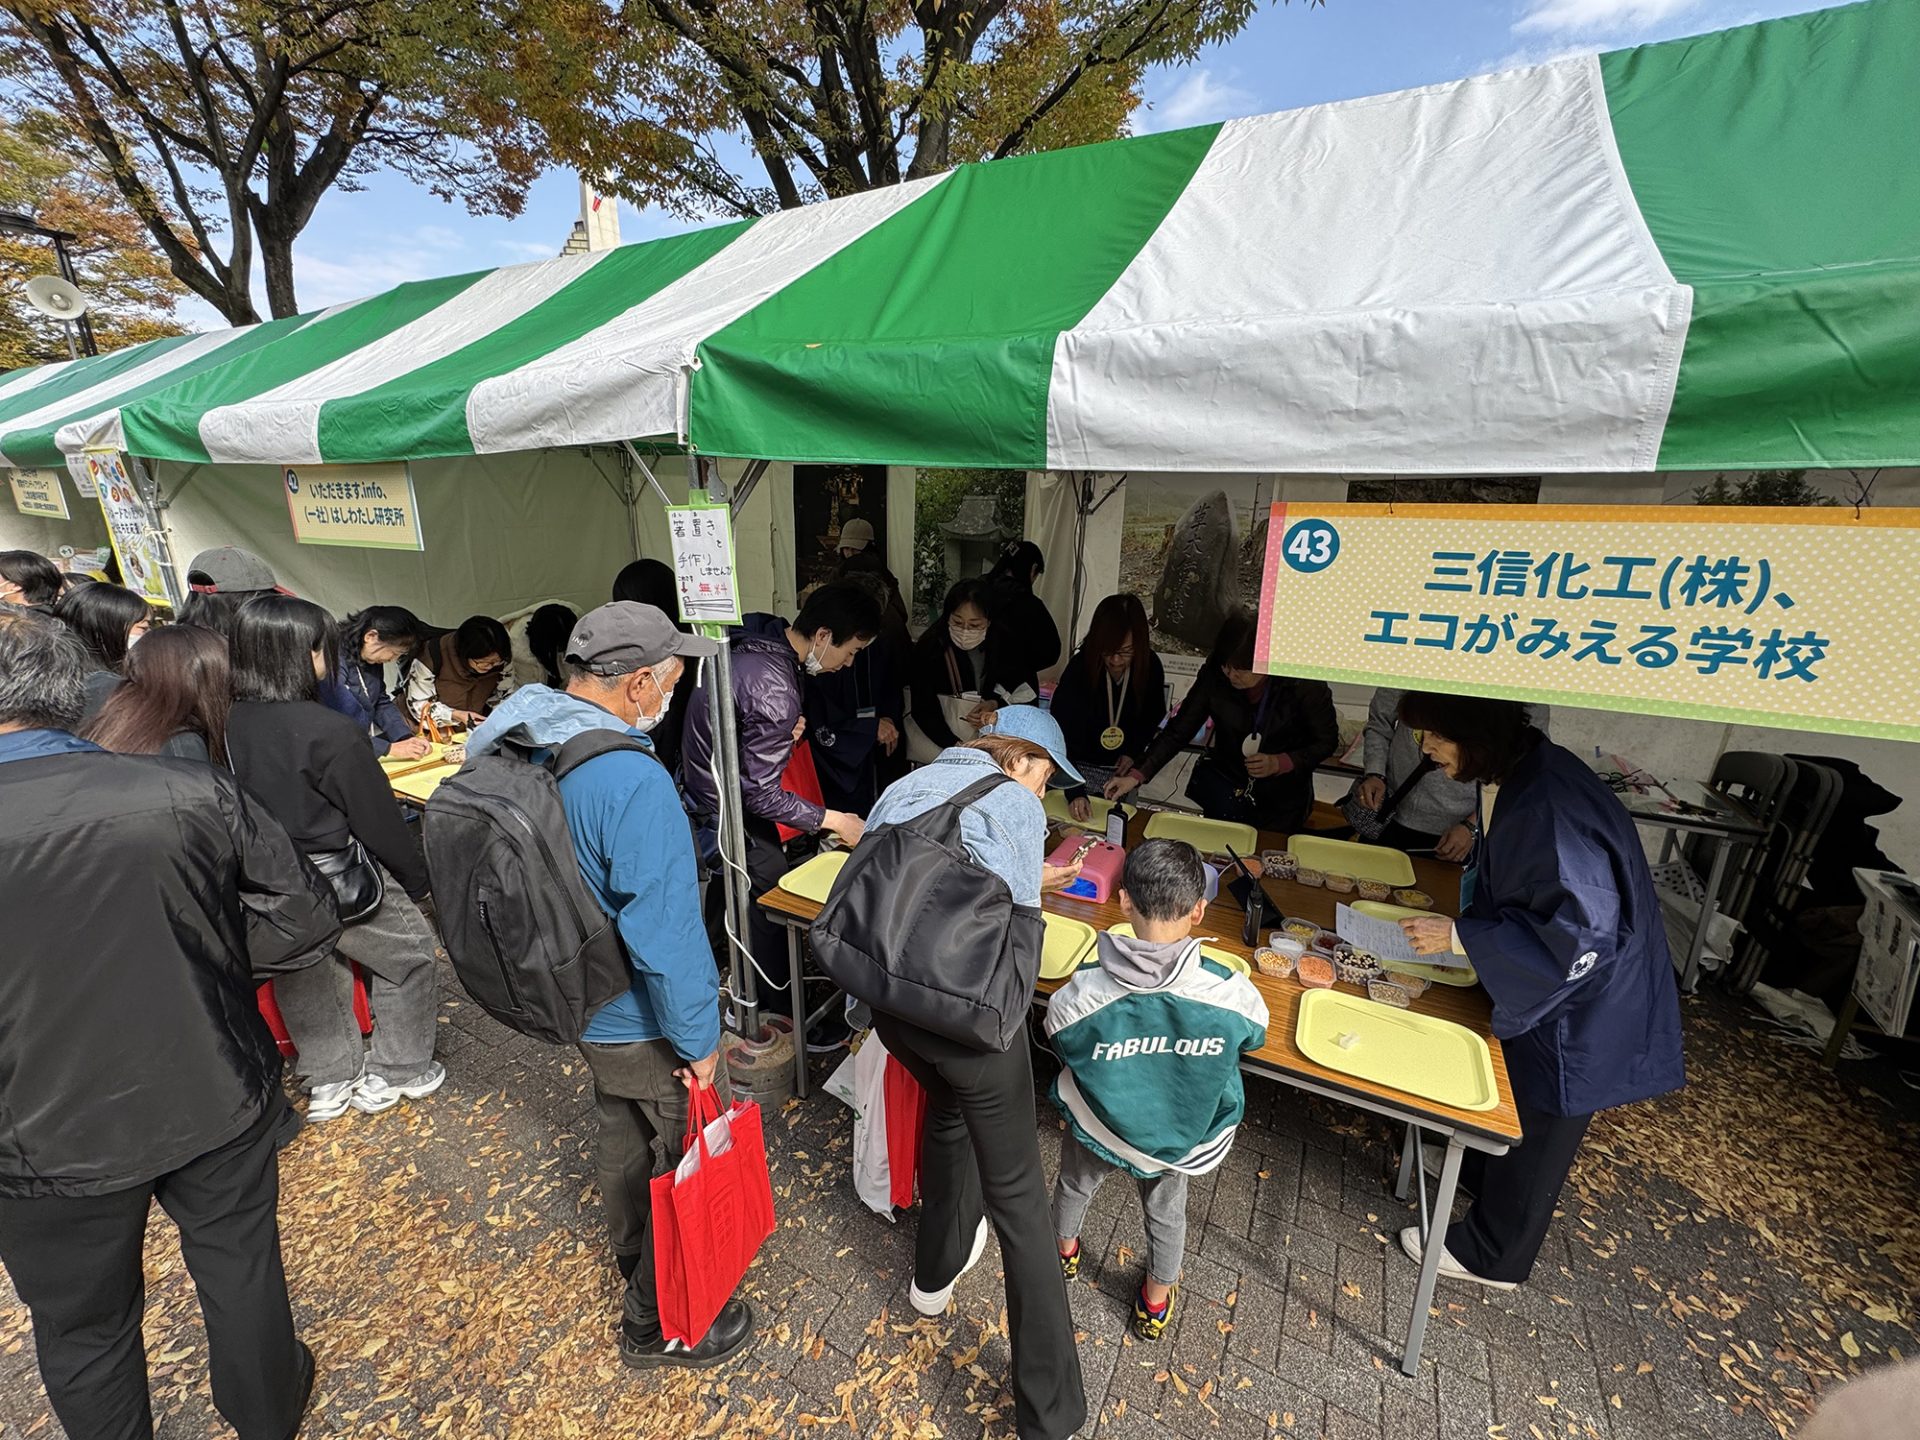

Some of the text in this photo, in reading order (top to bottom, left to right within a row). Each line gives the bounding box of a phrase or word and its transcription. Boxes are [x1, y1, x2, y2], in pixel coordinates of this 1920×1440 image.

[287, 472, 299, 490] 42
[309, 481, 388, 499] いただきます.info、
[1287, 527, 1332, 564] 43
[678, 552, 712, 569] 手作り
[699, 582, 728, 596] 無料
[1423, 549, 1796, 615] 三信化工(株)、
[1363, 609, 1830, 684] エコがみえる学校
[1091, 1036, 1226, 1061] FABULOUS
